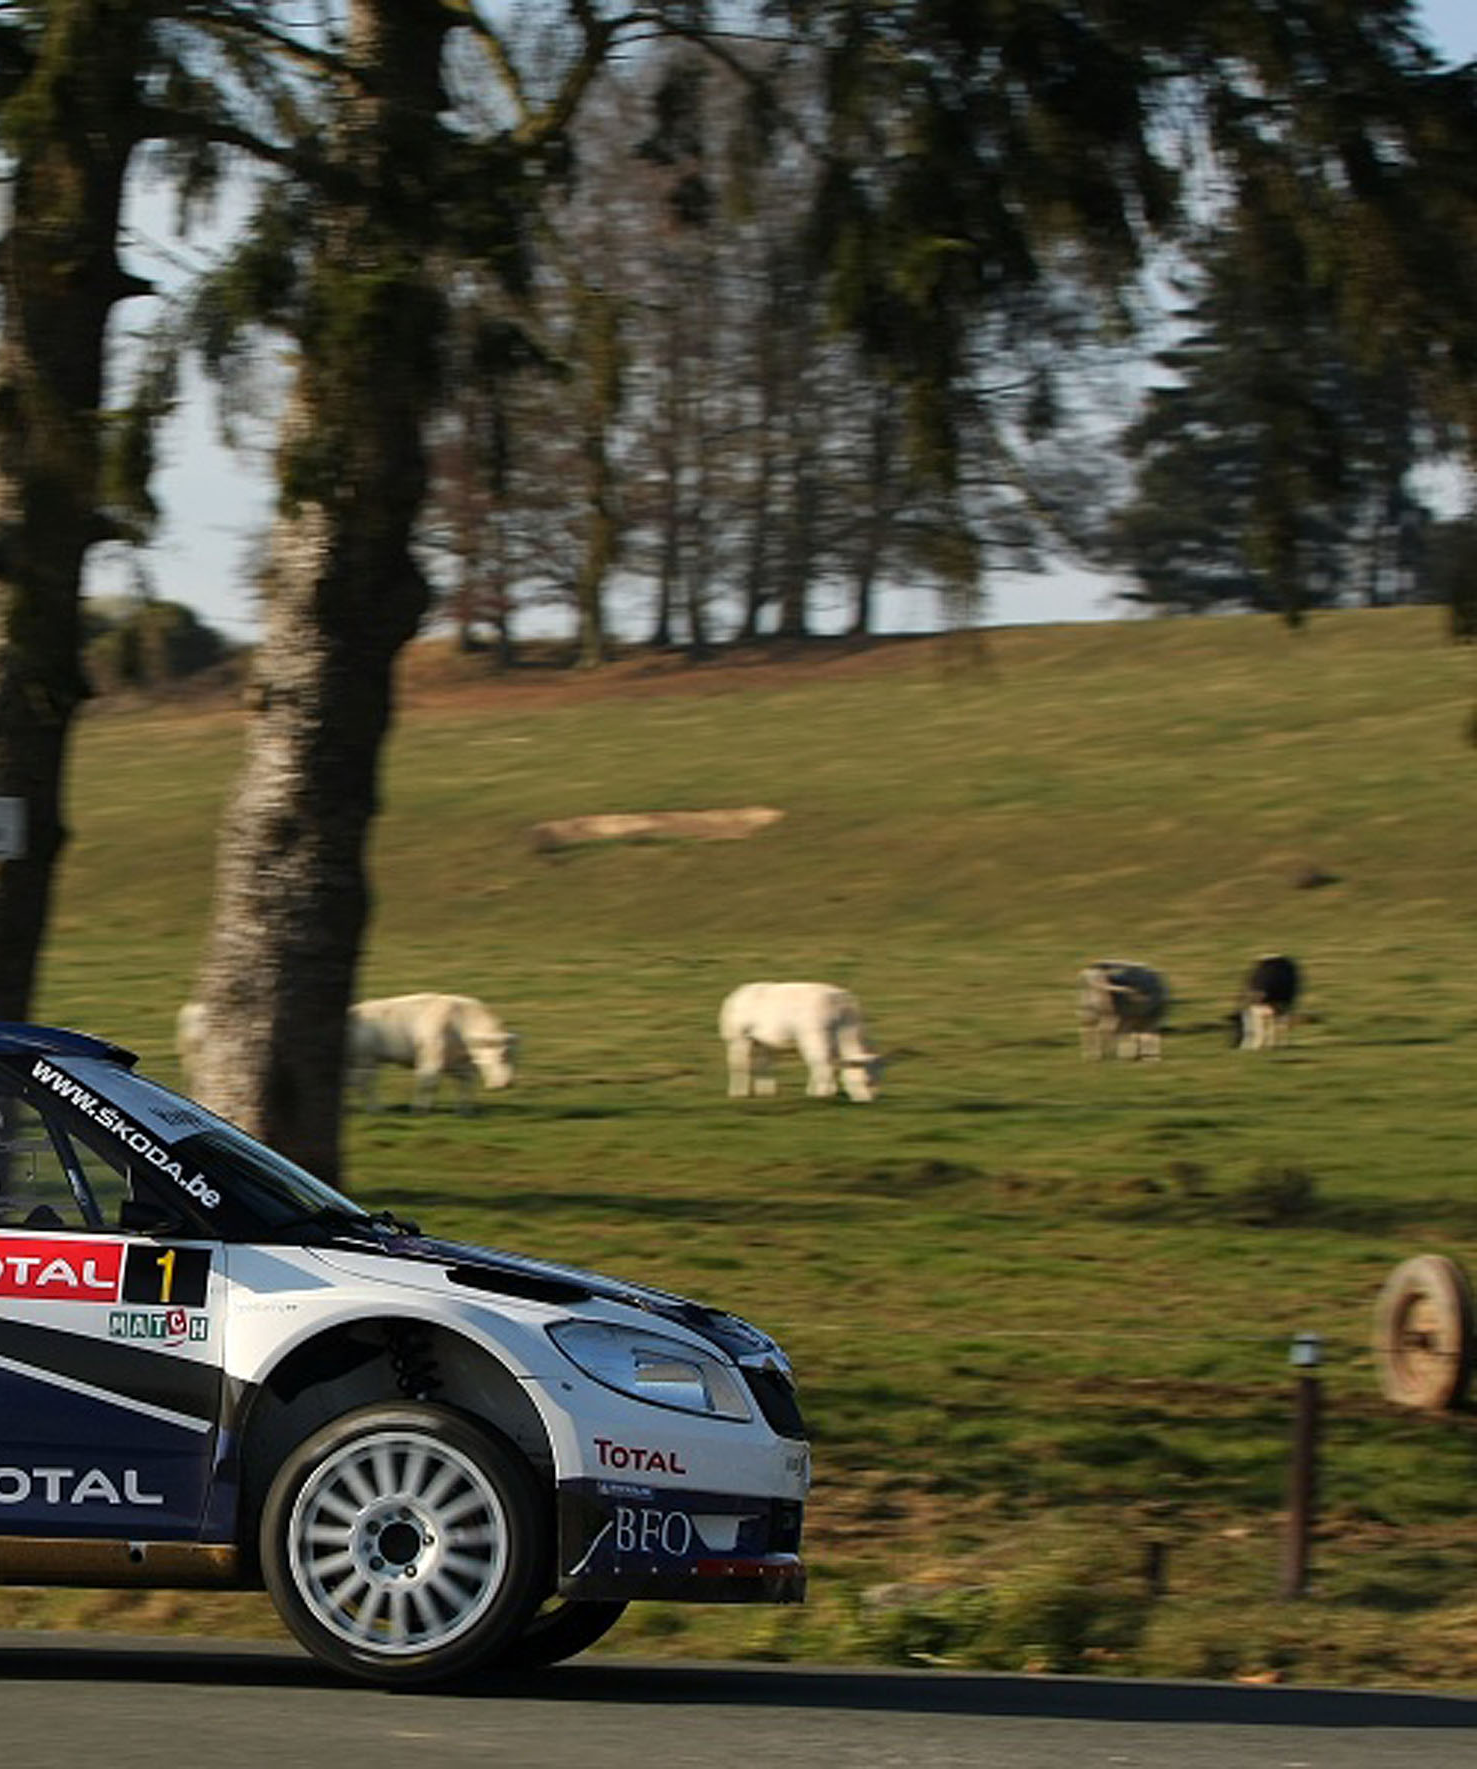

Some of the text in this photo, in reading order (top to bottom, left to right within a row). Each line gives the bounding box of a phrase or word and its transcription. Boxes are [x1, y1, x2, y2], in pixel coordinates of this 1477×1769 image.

[156, 1249, 177, 1303] 1
[109, 1309, 208, 1341] MATCH
[615, 1507, 692, 1556] BFO
